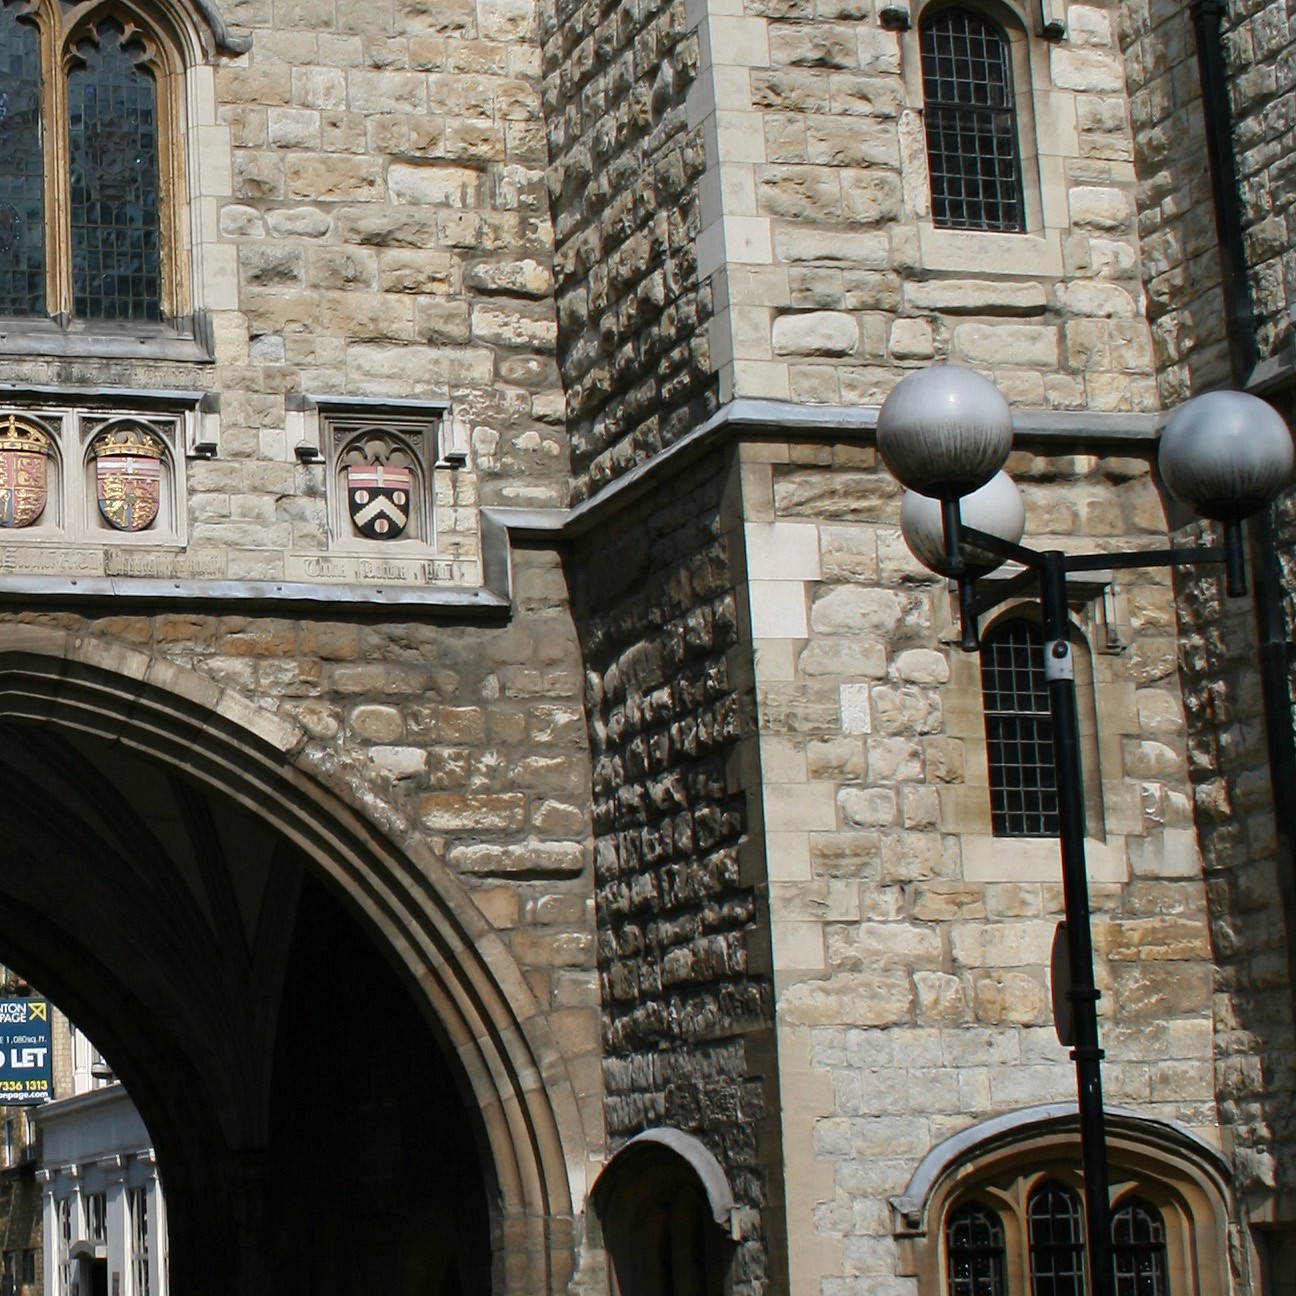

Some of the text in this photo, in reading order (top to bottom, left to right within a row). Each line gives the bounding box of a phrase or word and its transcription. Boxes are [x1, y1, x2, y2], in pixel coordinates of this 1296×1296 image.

[0, 1013, 26, 1023] PAGE
[10, 1048, 47, 1068] LET
[25, 1080, 48, 1091] 1313
